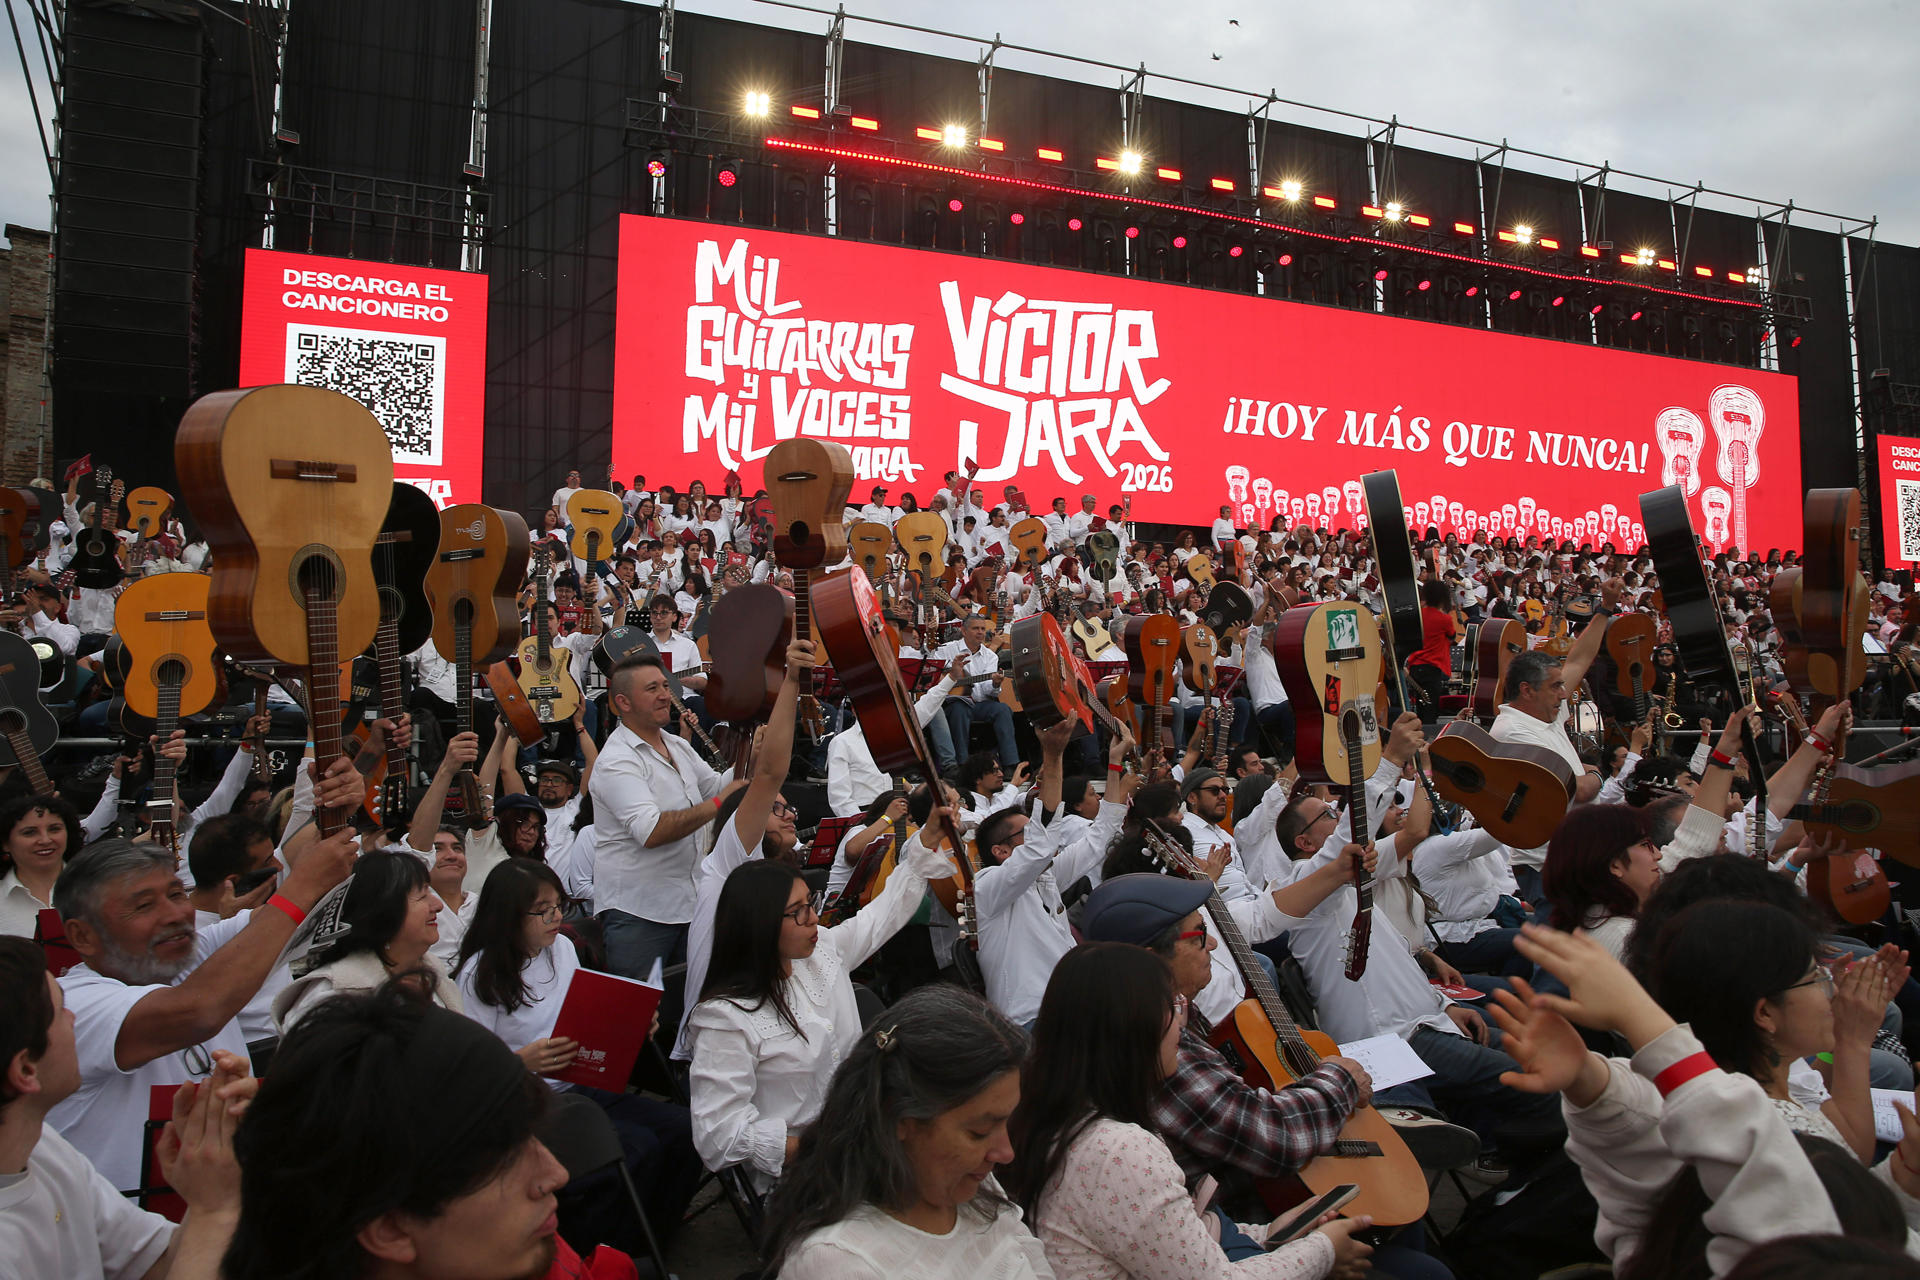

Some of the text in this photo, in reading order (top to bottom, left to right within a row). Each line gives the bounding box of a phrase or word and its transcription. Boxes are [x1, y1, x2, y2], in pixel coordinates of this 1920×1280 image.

[282, 291, 449, 323] CANCIONERO
[283, 268, 454, 302] DESCARGA EL
[939, 280, 1172, 406] VÍCTOR
[770, 375, 912, 441] VOCES
[939, 373, 1170, 485] JARA
[1223, 396, 1650, 474] ¡HOY MÁS QUE NUNCA!
[836, 442, 925, 484] ARA
[1119, 461, 1174, 493] 2026
